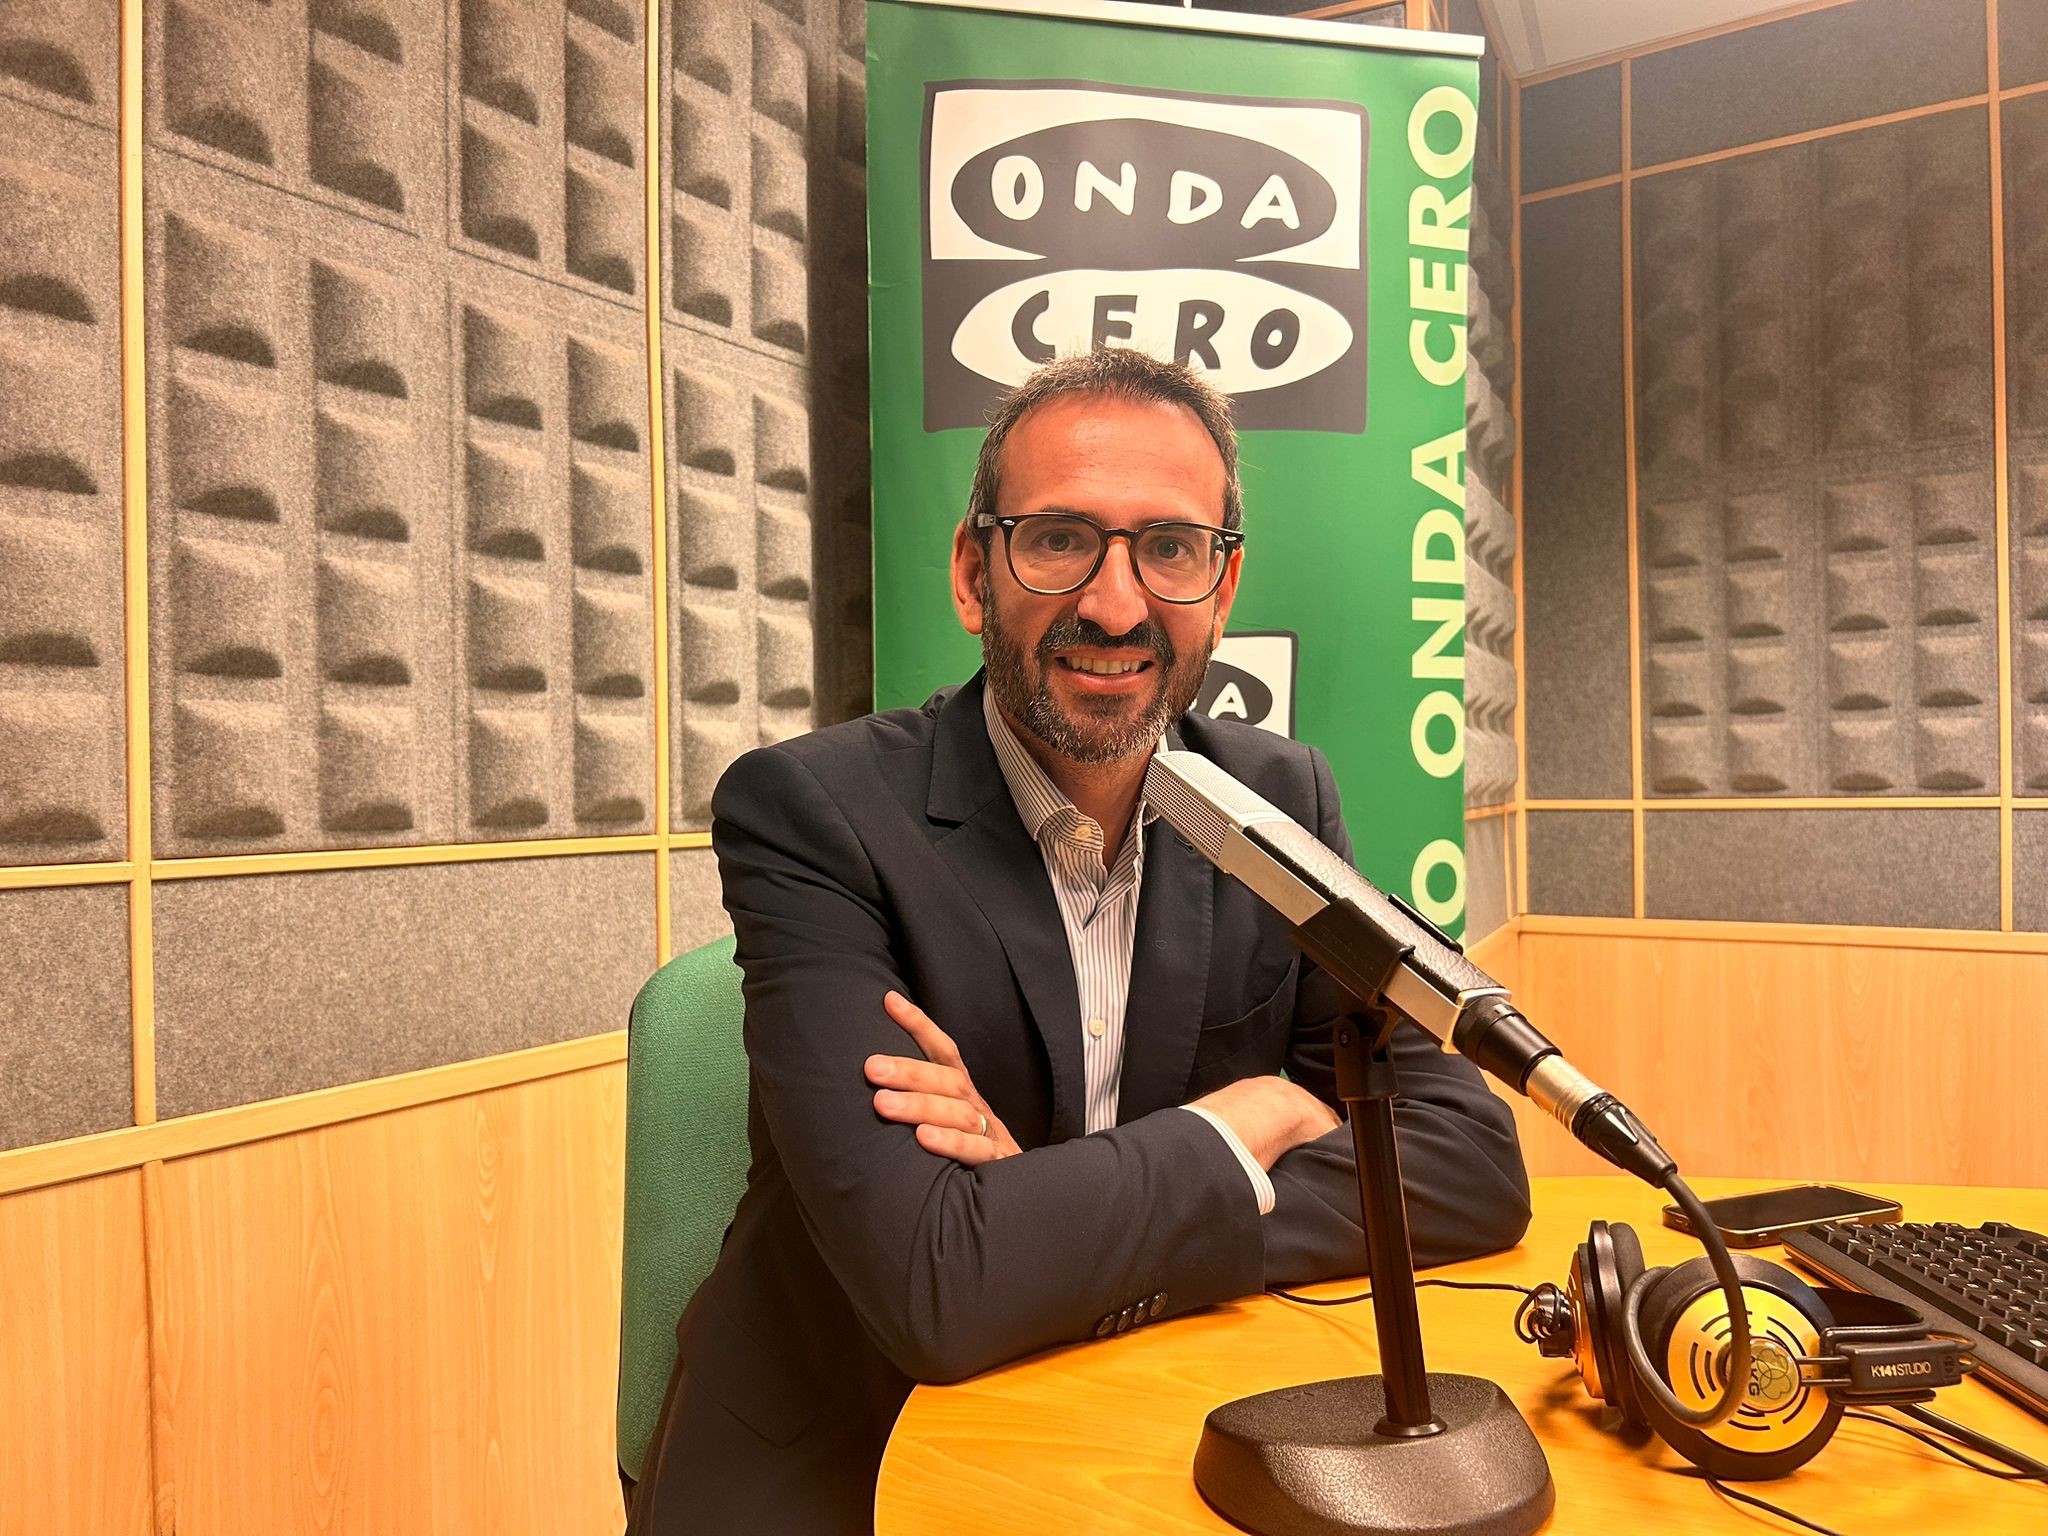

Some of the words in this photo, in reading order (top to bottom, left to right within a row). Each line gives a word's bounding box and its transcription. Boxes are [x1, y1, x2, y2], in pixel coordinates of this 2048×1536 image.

[991, 155, 1300, 230] ONDA
[1407, 86, 1478, 386] CERO
[1012, 290, 1300, 370] CERO
[1410, 428, 1466, 778] ONDA
